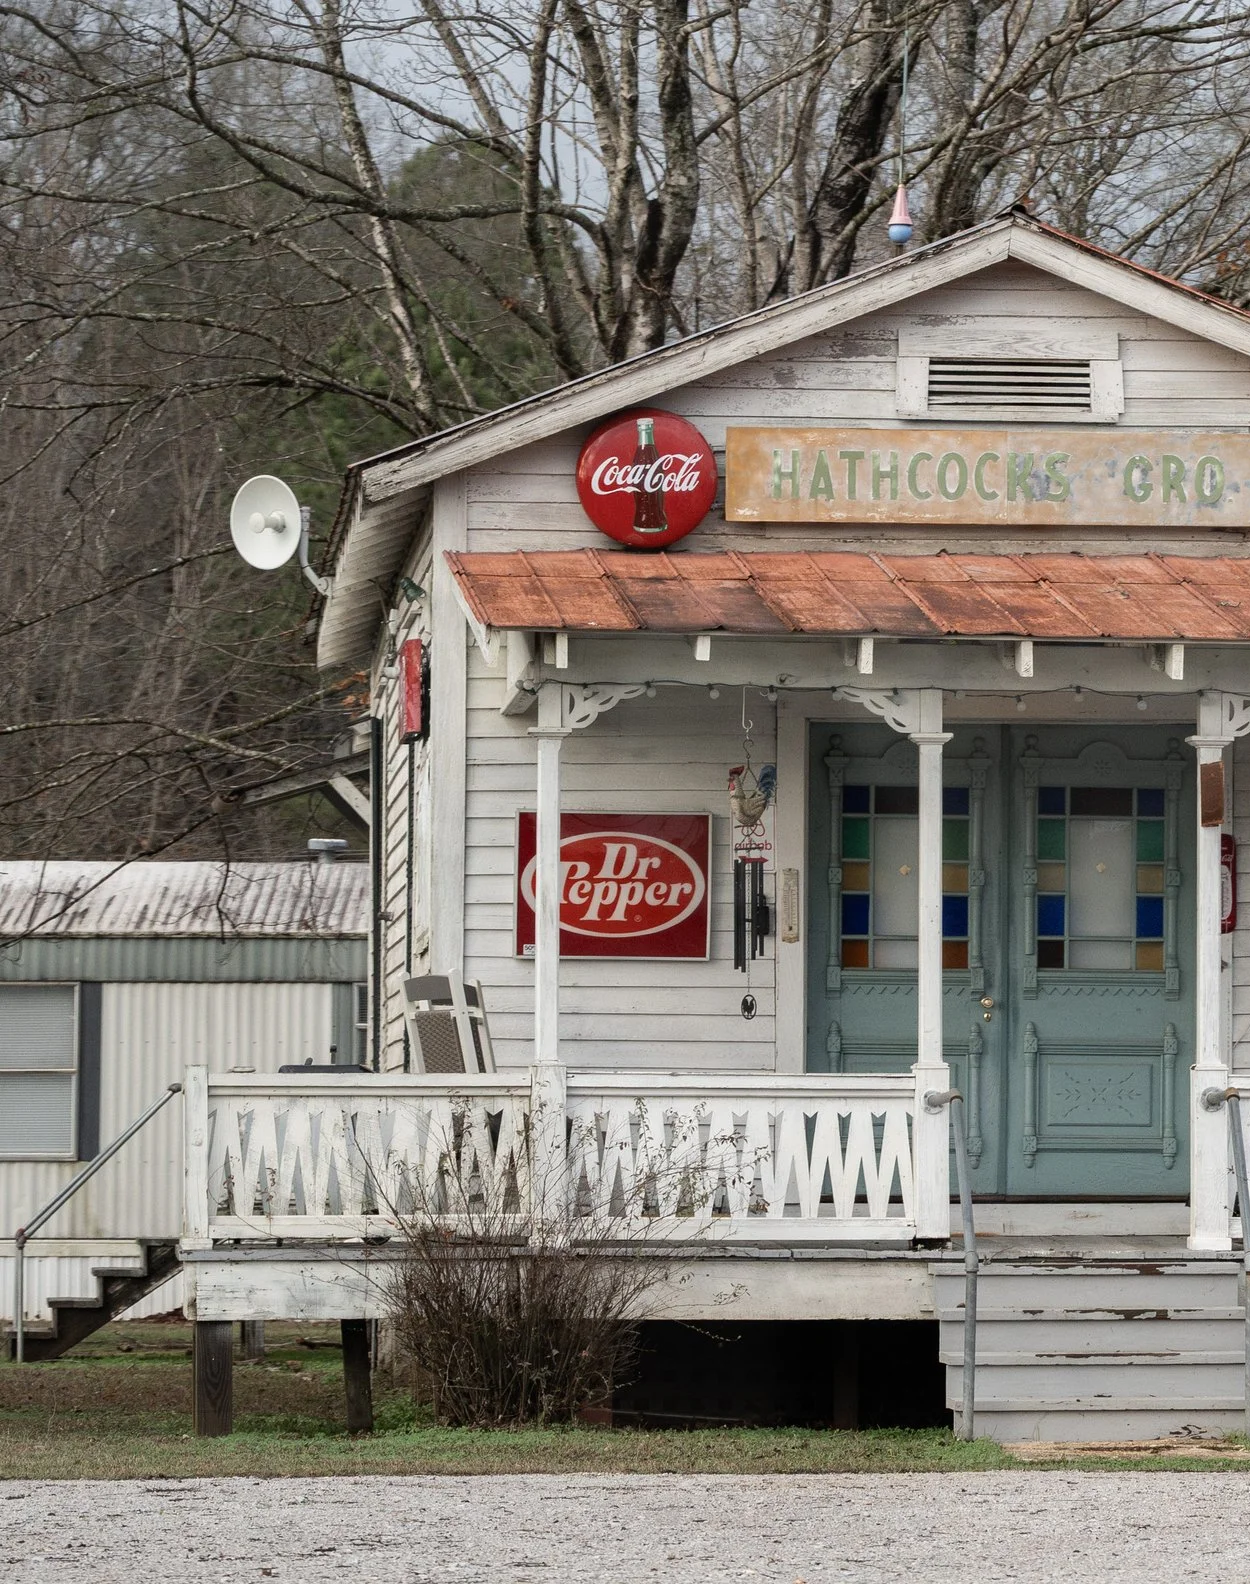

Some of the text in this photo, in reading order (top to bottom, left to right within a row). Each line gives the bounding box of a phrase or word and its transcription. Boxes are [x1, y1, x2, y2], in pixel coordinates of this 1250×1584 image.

[591, 453, 704, 495] Coca-Cola
[1123, 455, 1225, 504] GRO
[593, 842, 662, 880] Dr
